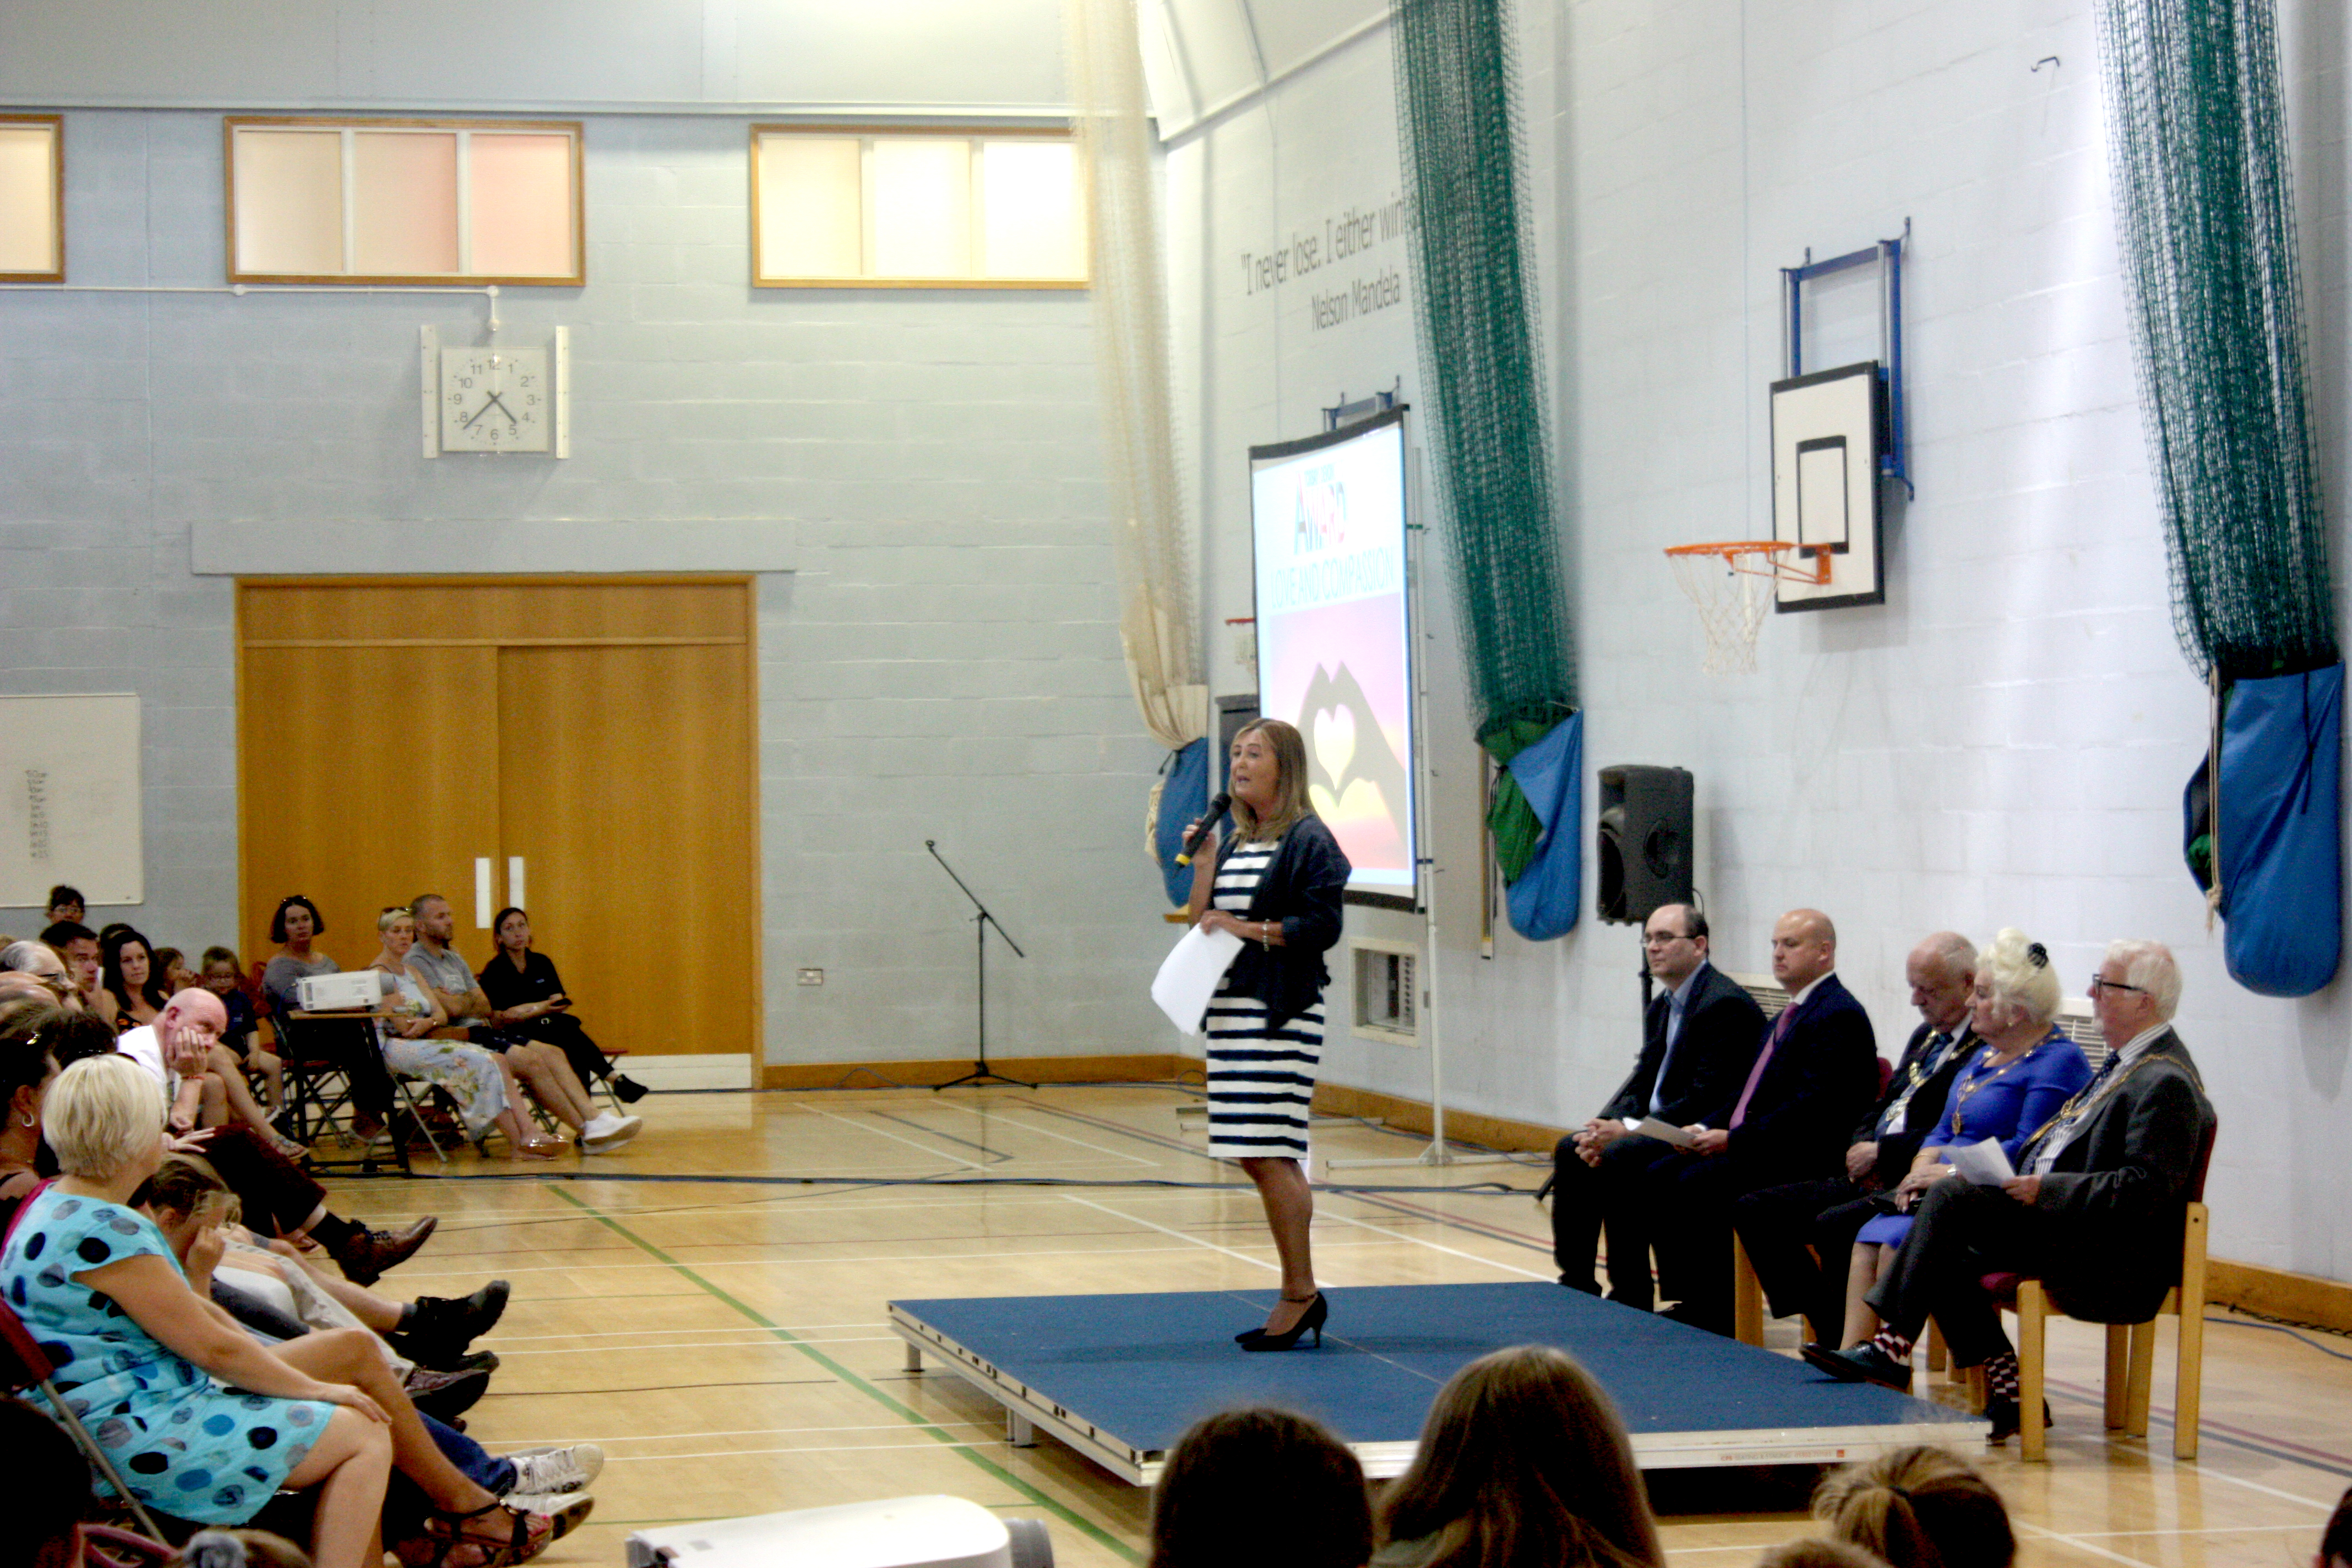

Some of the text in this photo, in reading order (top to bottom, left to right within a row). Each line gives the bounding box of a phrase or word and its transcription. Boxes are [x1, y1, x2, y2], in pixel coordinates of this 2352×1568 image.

[1255, 247, 1289, 292] never
[1292, 232, 1321, 278] lose.
[1325, 218, 1332, 264] I
[1335, 206, 1376, 259] either
[1379, 190, 1404, 243] win
[1311, 264, 1401, 333] Nelson Mandela
[471, 364, 482, 374] 11
[508, 363, 514, 374] 1
[459, 377, 472, 389] 10
[520, 376, 530, 388] 2
[453, 394, 462, 405] 9
[526, 395, 535, 406] 3
[460, 412, 469, 423] 8
[522, 412, 530, 422] 4
[473, 424, 483, 436] 7
[490, 428, 499, 440] 6
[508, 424, 518, 435] 5
[1271, 546, 1394, 609] LOVE AND COMPASSION
